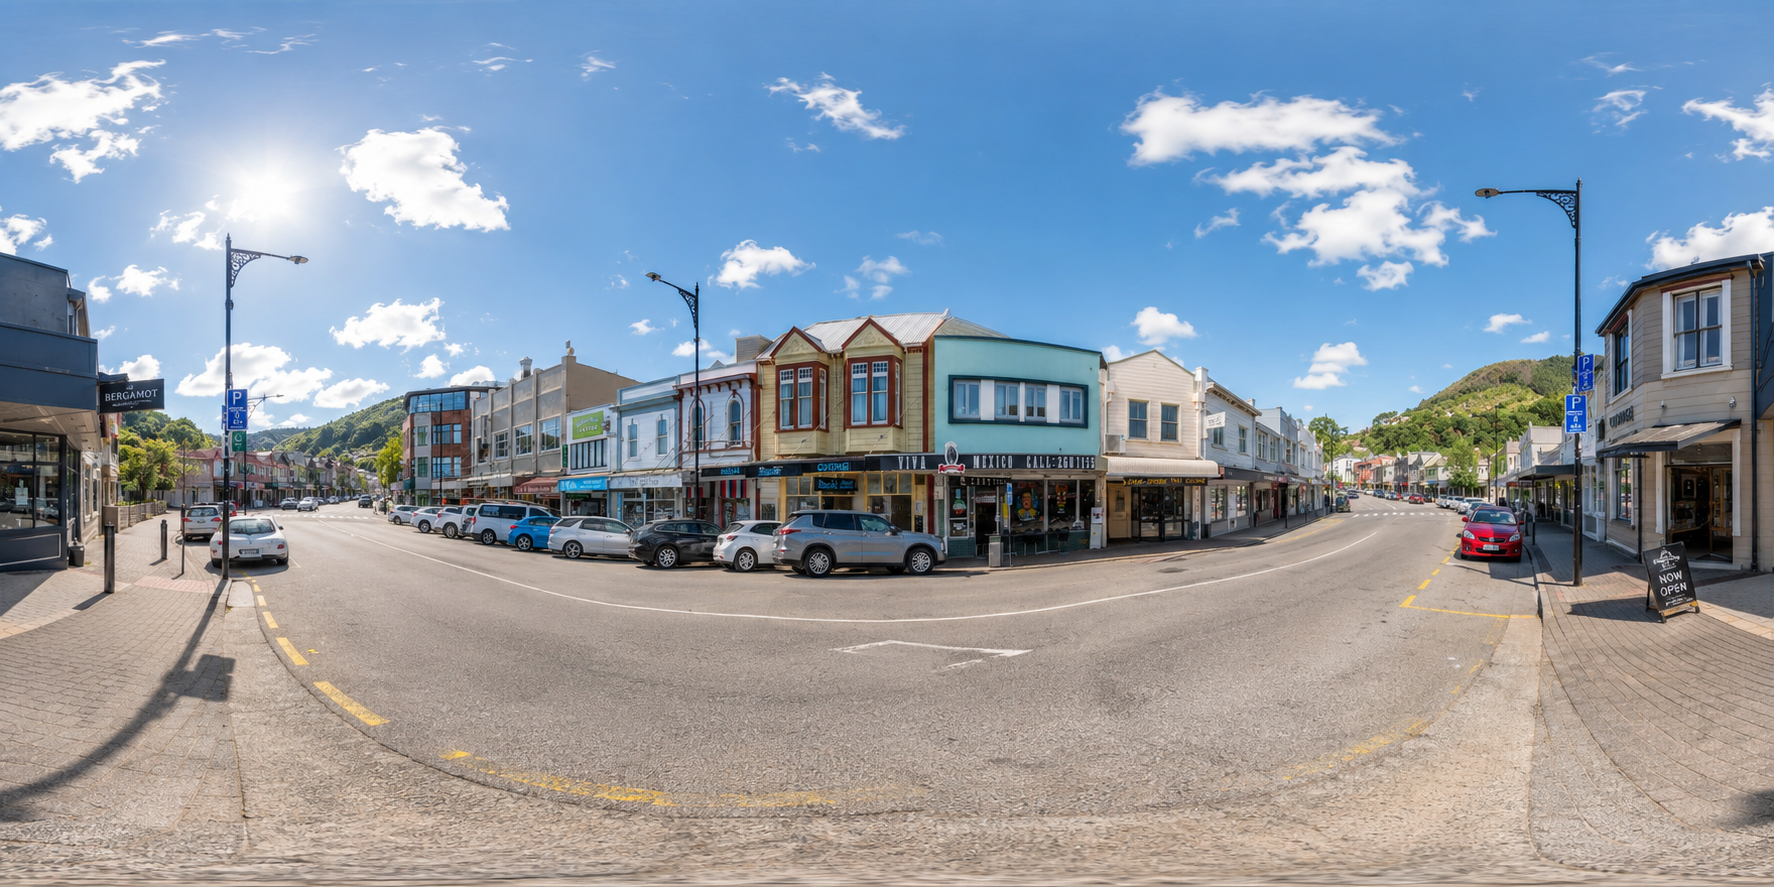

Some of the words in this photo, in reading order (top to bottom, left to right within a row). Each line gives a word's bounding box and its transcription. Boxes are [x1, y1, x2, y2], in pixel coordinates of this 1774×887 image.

[1583, 356, 1590, 370] P
[105, 389, 158, 402] BERGAMOT
[233, 391, 242, 405] P
[1572, 396, 1581, 409] P
[898, 455, 926, 470] VIVA
[973, 455, 1013, 469] MEXICO
[1659, 570, 1682, 584] NOW
[1660, 582, 1687, 597] OPEN
